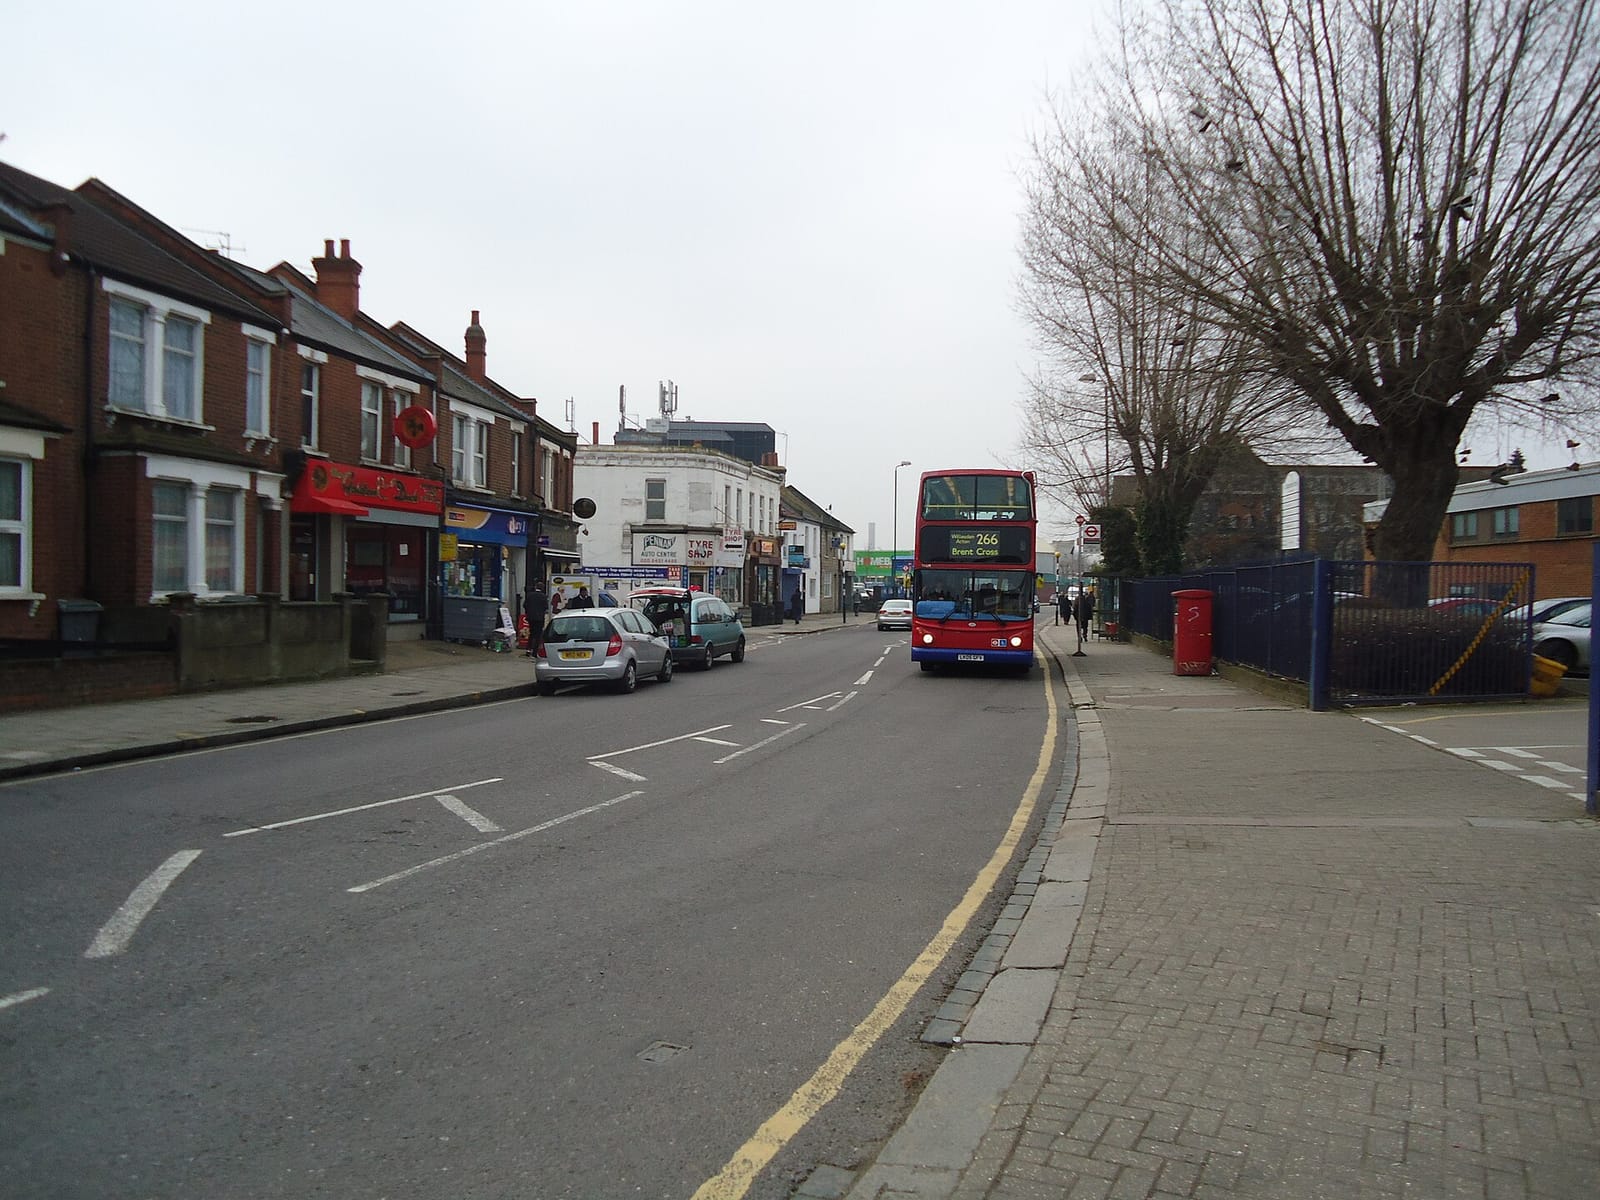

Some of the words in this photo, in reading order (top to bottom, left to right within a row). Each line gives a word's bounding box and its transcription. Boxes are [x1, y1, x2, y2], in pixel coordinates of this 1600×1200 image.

[976, 533, 999, 545] 266
[688, 540, 713, 549] TYRE
[687, 550, 713, 559] SHOP
[952, 547, 974, 556] Brent
[975, 547, 999, 556] Cross
